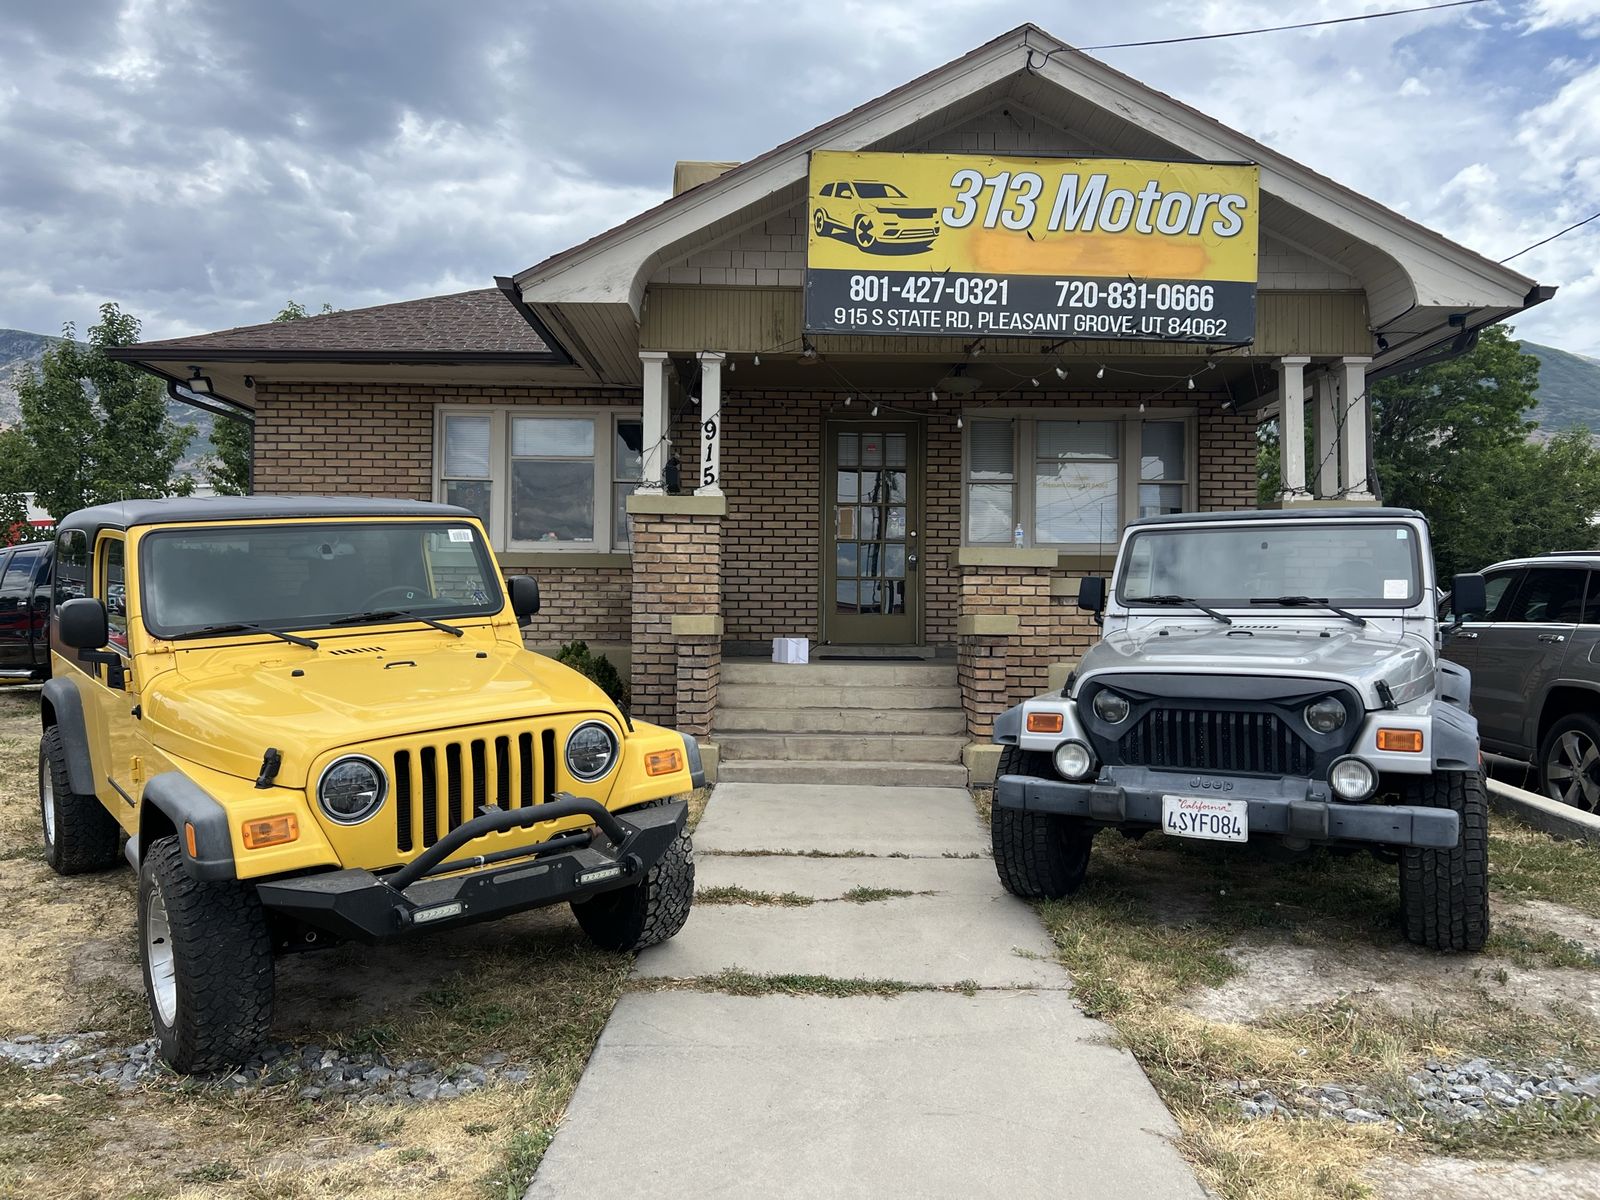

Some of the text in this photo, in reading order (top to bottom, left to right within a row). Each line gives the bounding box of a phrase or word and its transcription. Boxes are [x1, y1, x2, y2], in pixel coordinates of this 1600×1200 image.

[941, 169, 1247, 237] 313 Motors
[850, 275, 1008, 306] 801-427-0321
[1055, 281, 1214, 312] 720-831-0666
[834, 307, 1227, 336] 915 S STATE RD, PLEASANT GROVE, UT 84062
[704, 419, 717, 486] 915
[1190, 777, 1234, 792] Jeep
[1180, 800, 1232, 812] California
[1167, 811, 1242, 836] 4SYF084
